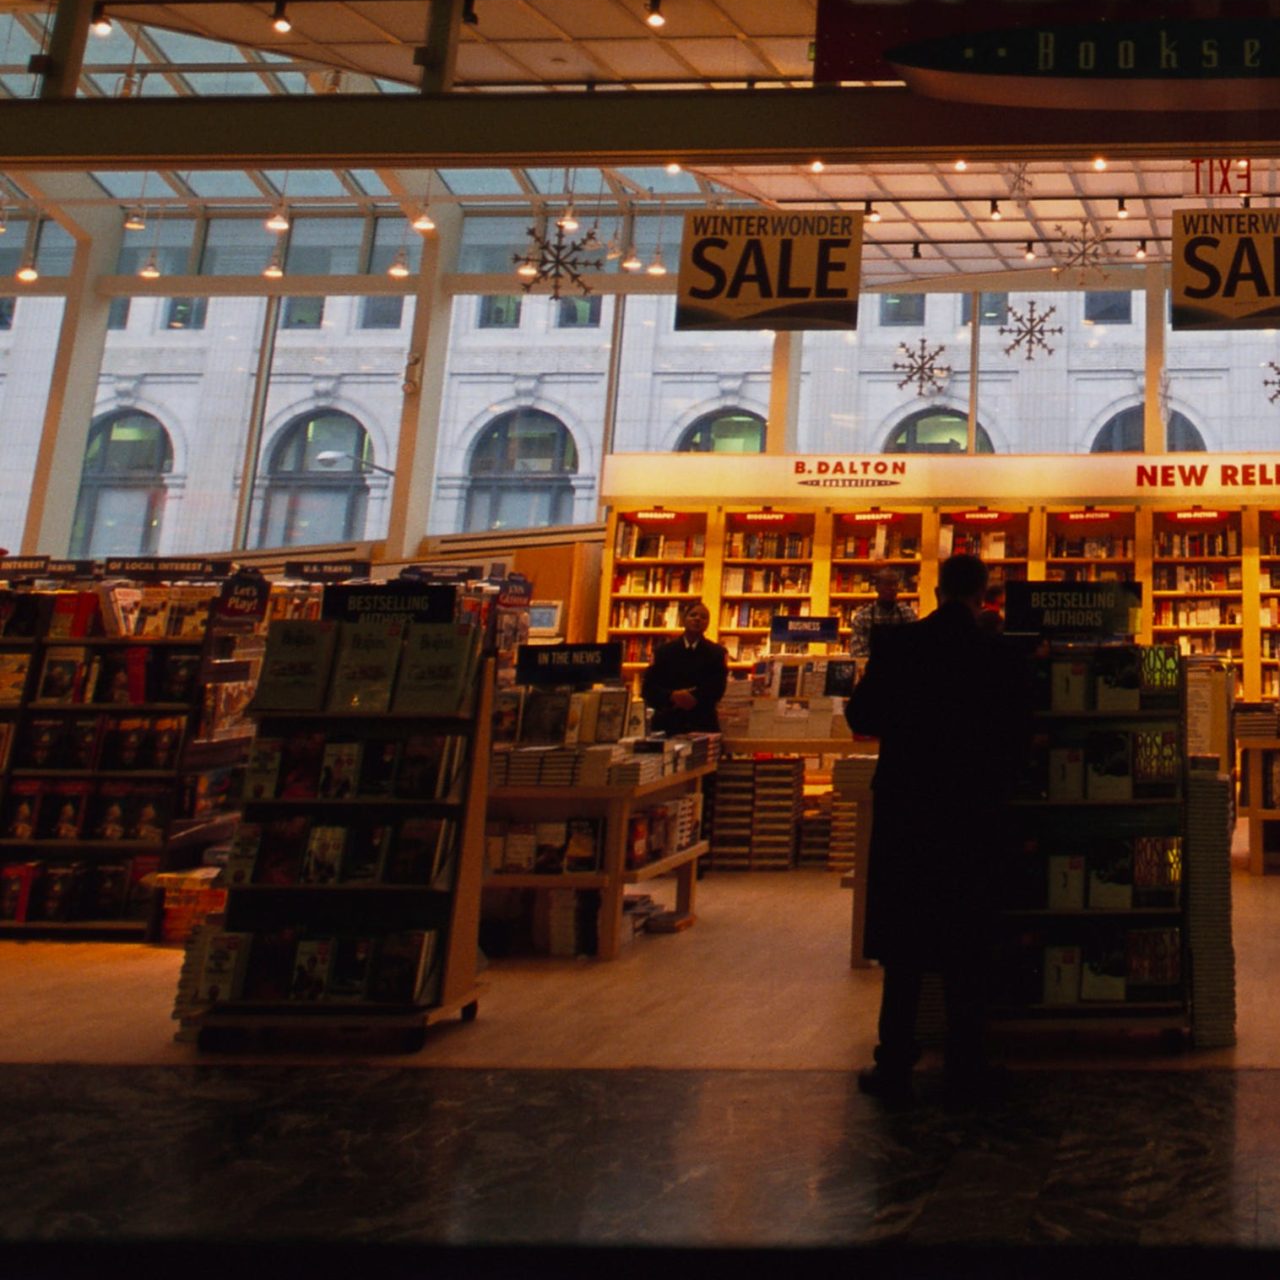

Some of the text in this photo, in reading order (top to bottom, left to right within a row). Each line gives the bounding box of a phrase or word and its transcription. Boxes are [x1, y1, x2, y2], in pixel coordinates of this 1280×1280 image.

[689, 238, 851, 299] SALE
[795, 461, 906, 475] B. DALTON
[1136, 464, 1208, 487] NEW
[125, 561, 154, 570] LOCAL
[227, 597, 258, 612] Play!
[348, 595, 430, 611] BESTSELLING
[1031, 591, 1115, 609] BESTSELLING
[1043, 609, 1103, 627] AUTHORS
[537, 651, 602, 665] IN THE NEWS
